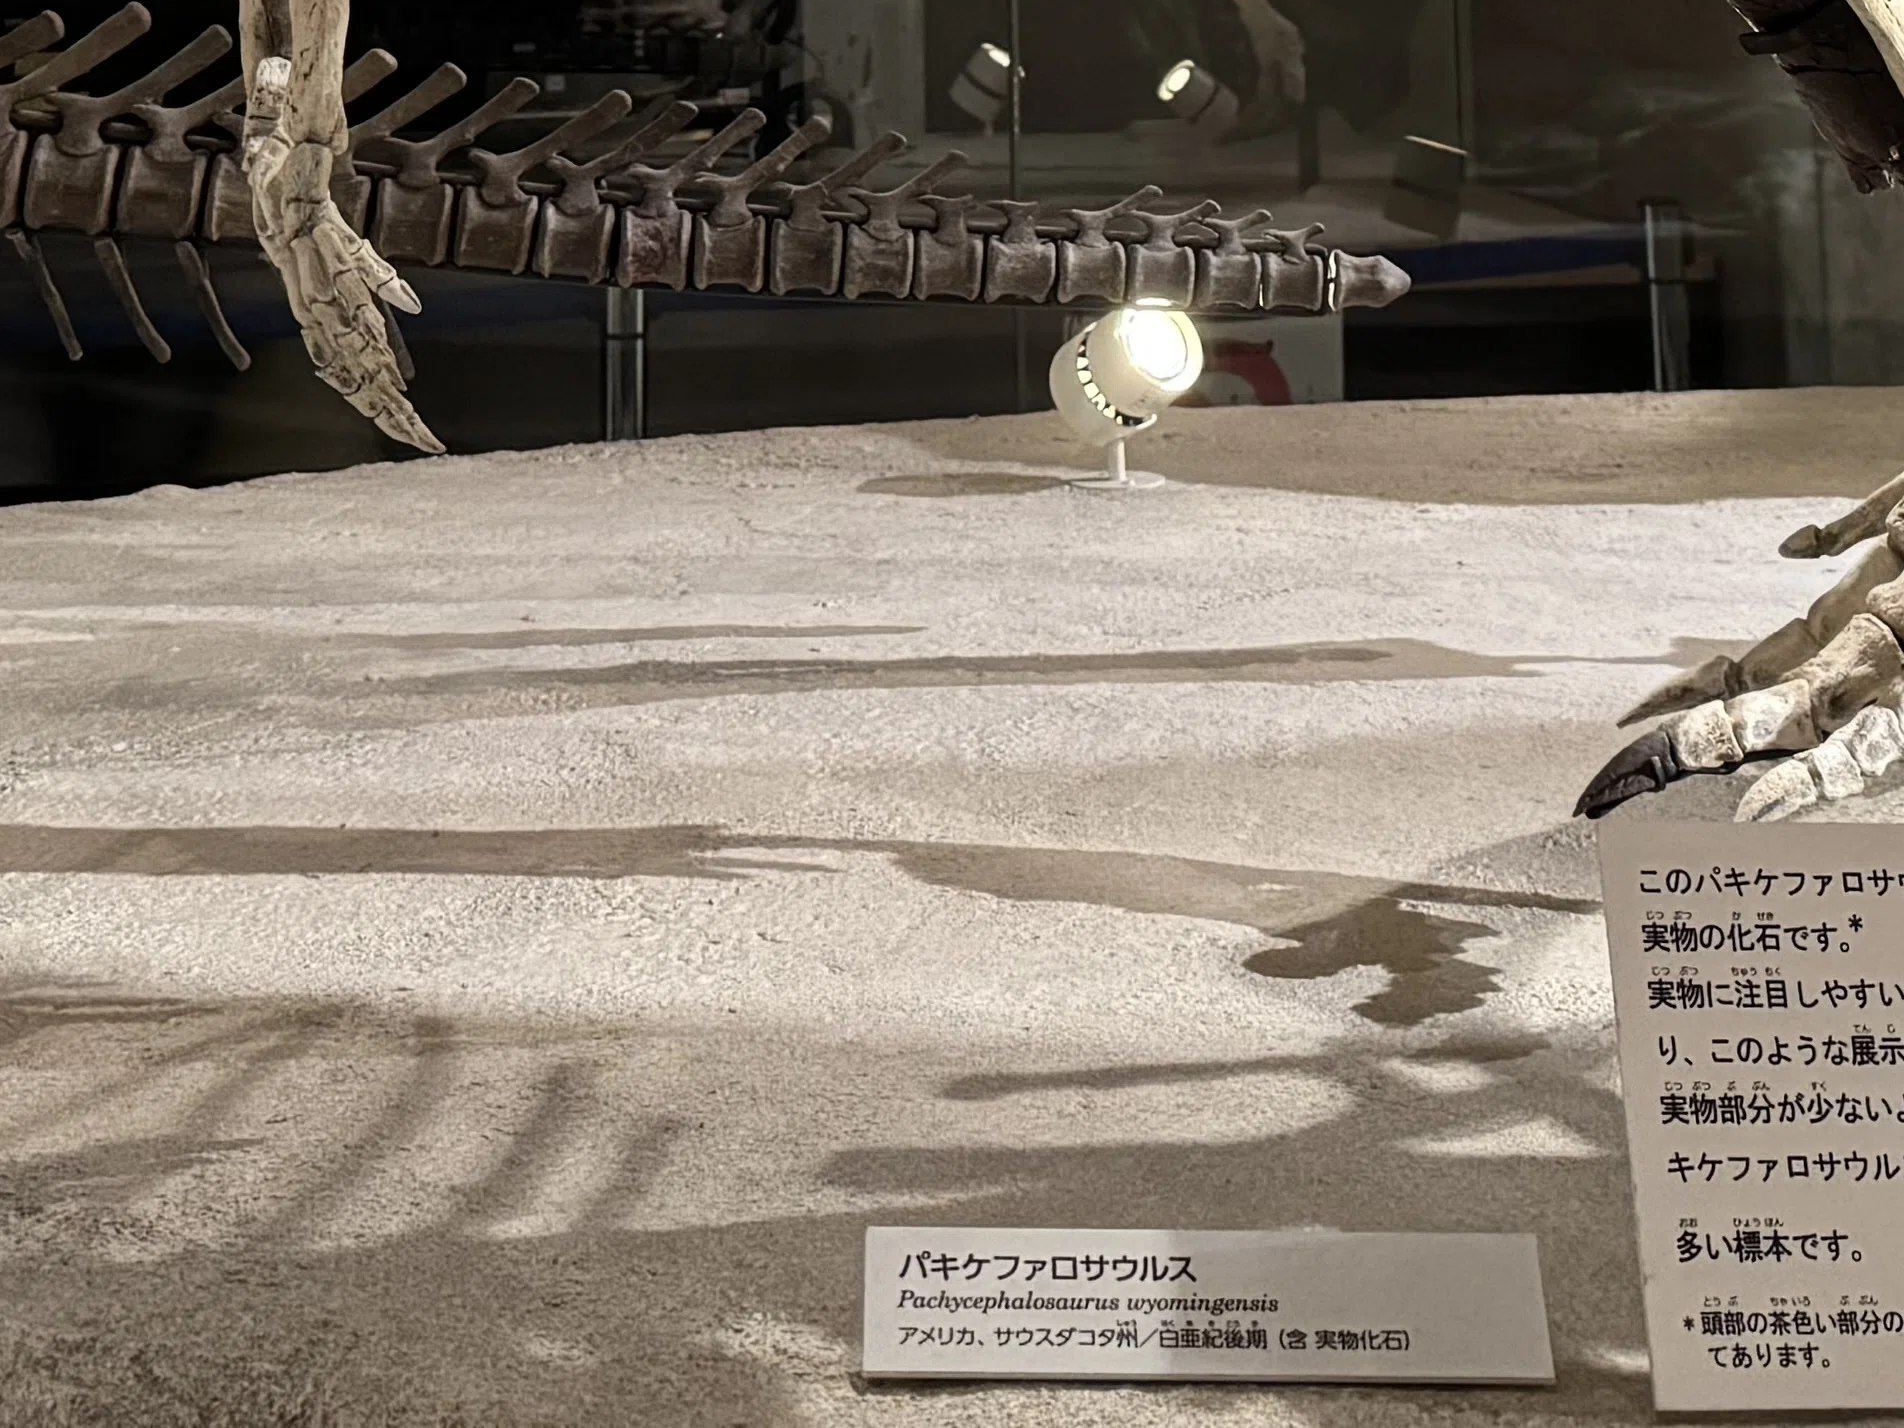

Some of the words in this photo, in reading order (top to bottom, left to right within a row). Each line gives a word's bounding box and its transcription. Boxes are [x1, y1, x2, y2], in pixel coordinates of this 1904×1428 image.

[1676, 1228, 1863, 1264] 多い標本です。
[898, 1250, 1198, 1283] パキケファロサウルス
[896, 1289, 1121, 1315] Pachycephalosaurus
[1126, 1292, 1279, 1317] wyomingensis
[1707, 1341, 1831, 1370] てあります。
